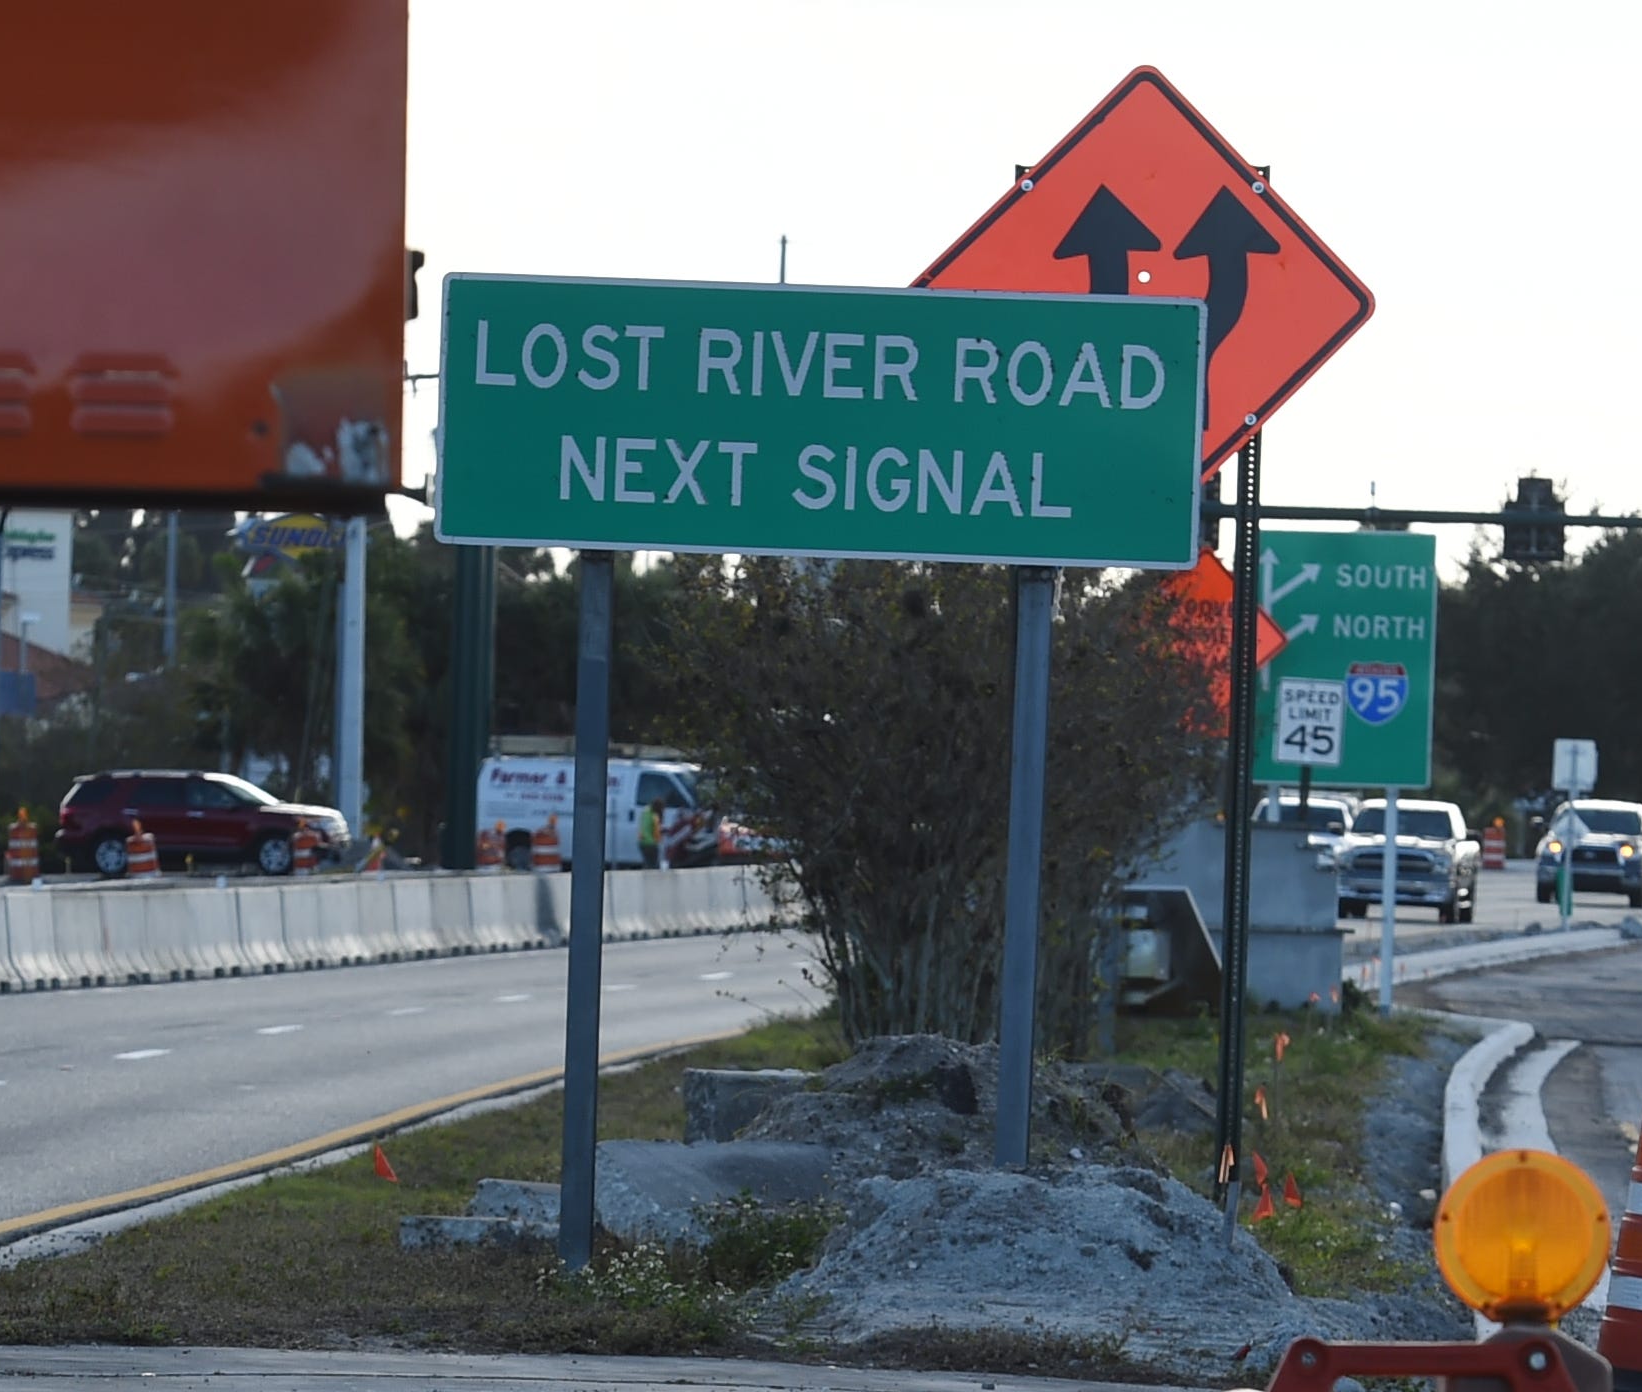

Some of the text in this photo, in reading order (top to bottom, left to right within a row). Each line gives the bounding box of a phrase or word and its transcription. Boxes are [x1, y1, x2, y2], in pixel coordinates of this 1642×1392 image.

[475, 319, 1165, 410] LOST RIVER ROAD
[559, 434, 1072, 518] NEXT SIGNAL
[1335, 563, 1427, 590] SOUTH
[1333, 613, 1425, 640] NORTH
[1283, 687, 1340, 706] SPEED
[1351, 678, 1401, 715] 95
[1288, 707, 1332, 722] LIMIT
[1283, 724, 1335, 756] 45
